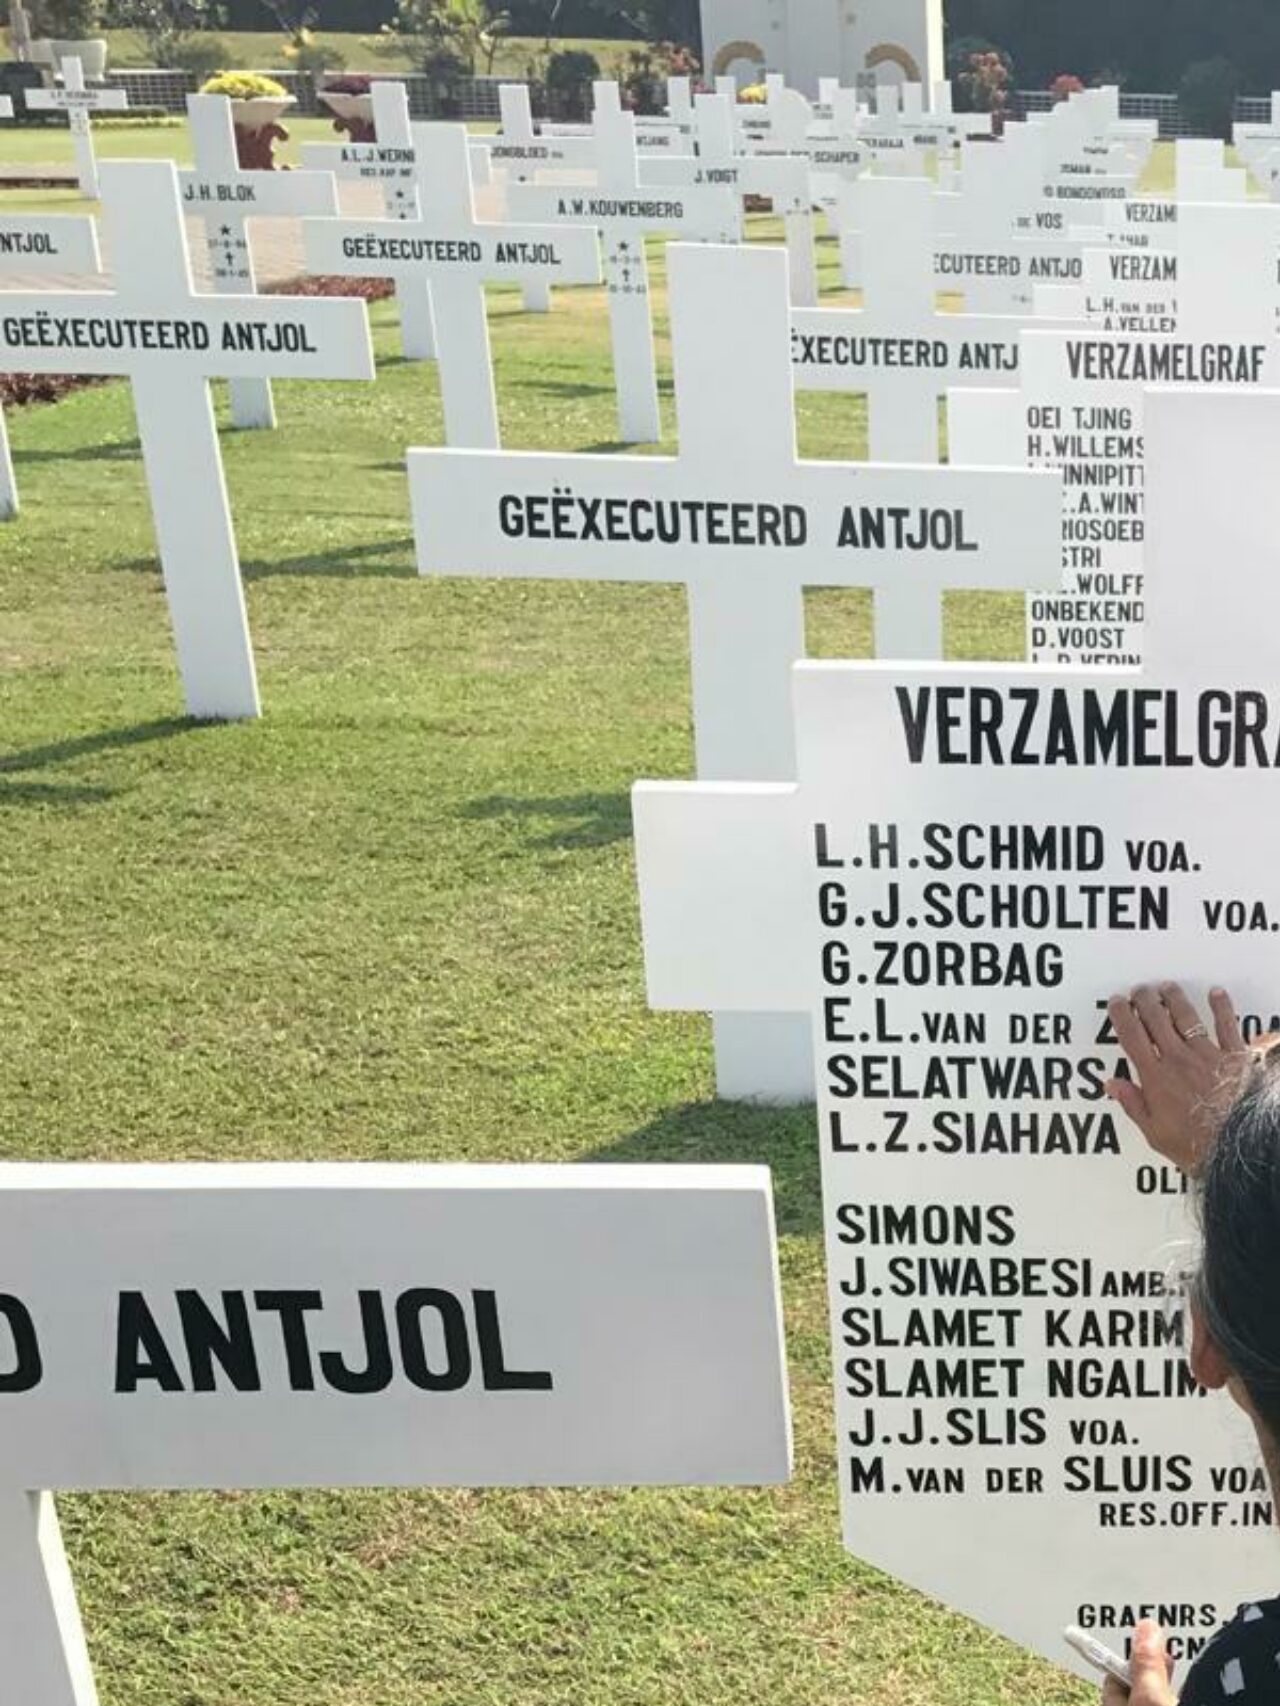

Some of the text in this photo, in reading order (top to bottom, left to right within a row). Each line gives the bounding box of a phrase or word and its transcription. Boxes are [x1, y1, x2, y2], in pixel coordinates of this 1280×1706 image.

[184, 184, 257, 202] J.H.BLOK
[557, 198, 684, 218] A.W.KOUWENBERG
[1035, 212, 1063, 230] VOS
[342, 232, 561, 265] GEËXECUTEERD ANTJOL
[3, 311, 317, 353] GEËXECUTEERD ANTJOL
[1066, 340, 1266, 384] VERZAMELGRAF
[1027, 405, 1132, 431] OEI TJING
[498, 487, 979, 552] GEËXECUTEERD ANTJOL
[1031, 626, 1125, 649] D.VOOST
[814, 822, 1201, 872] L.H.SCHMID VOA.
[818, 881, 1280, 932] G.J.SCHOLTEN VOA.
[821, 940, 1064, 988] G.ZORBAG
[824, 997, 986, 1045] E.L.VAN
[1009, 1013, 1072, 1045] DER
[830, 1111, 1121, 1156] L.Z.SIAHAYA
[836, 1203, 1015, 1246] SIMONS
[840, 1256, 1093, 1299] J.SIWABESI
[114, 1287, 553, 1394] ANTJOL
[842, 1307, 1185, 1348] SLAMET KARIM
[845, 1357, 1024, 1399] SLAMET
[848, 1406, 1140, 1447] J.J.SLIS VOA.
[850, 1456, 964, 1494] M.VAN
[986, 1466, 1043, 1494] DER
[1063, 1454, 1193, 1494] SLUIS
